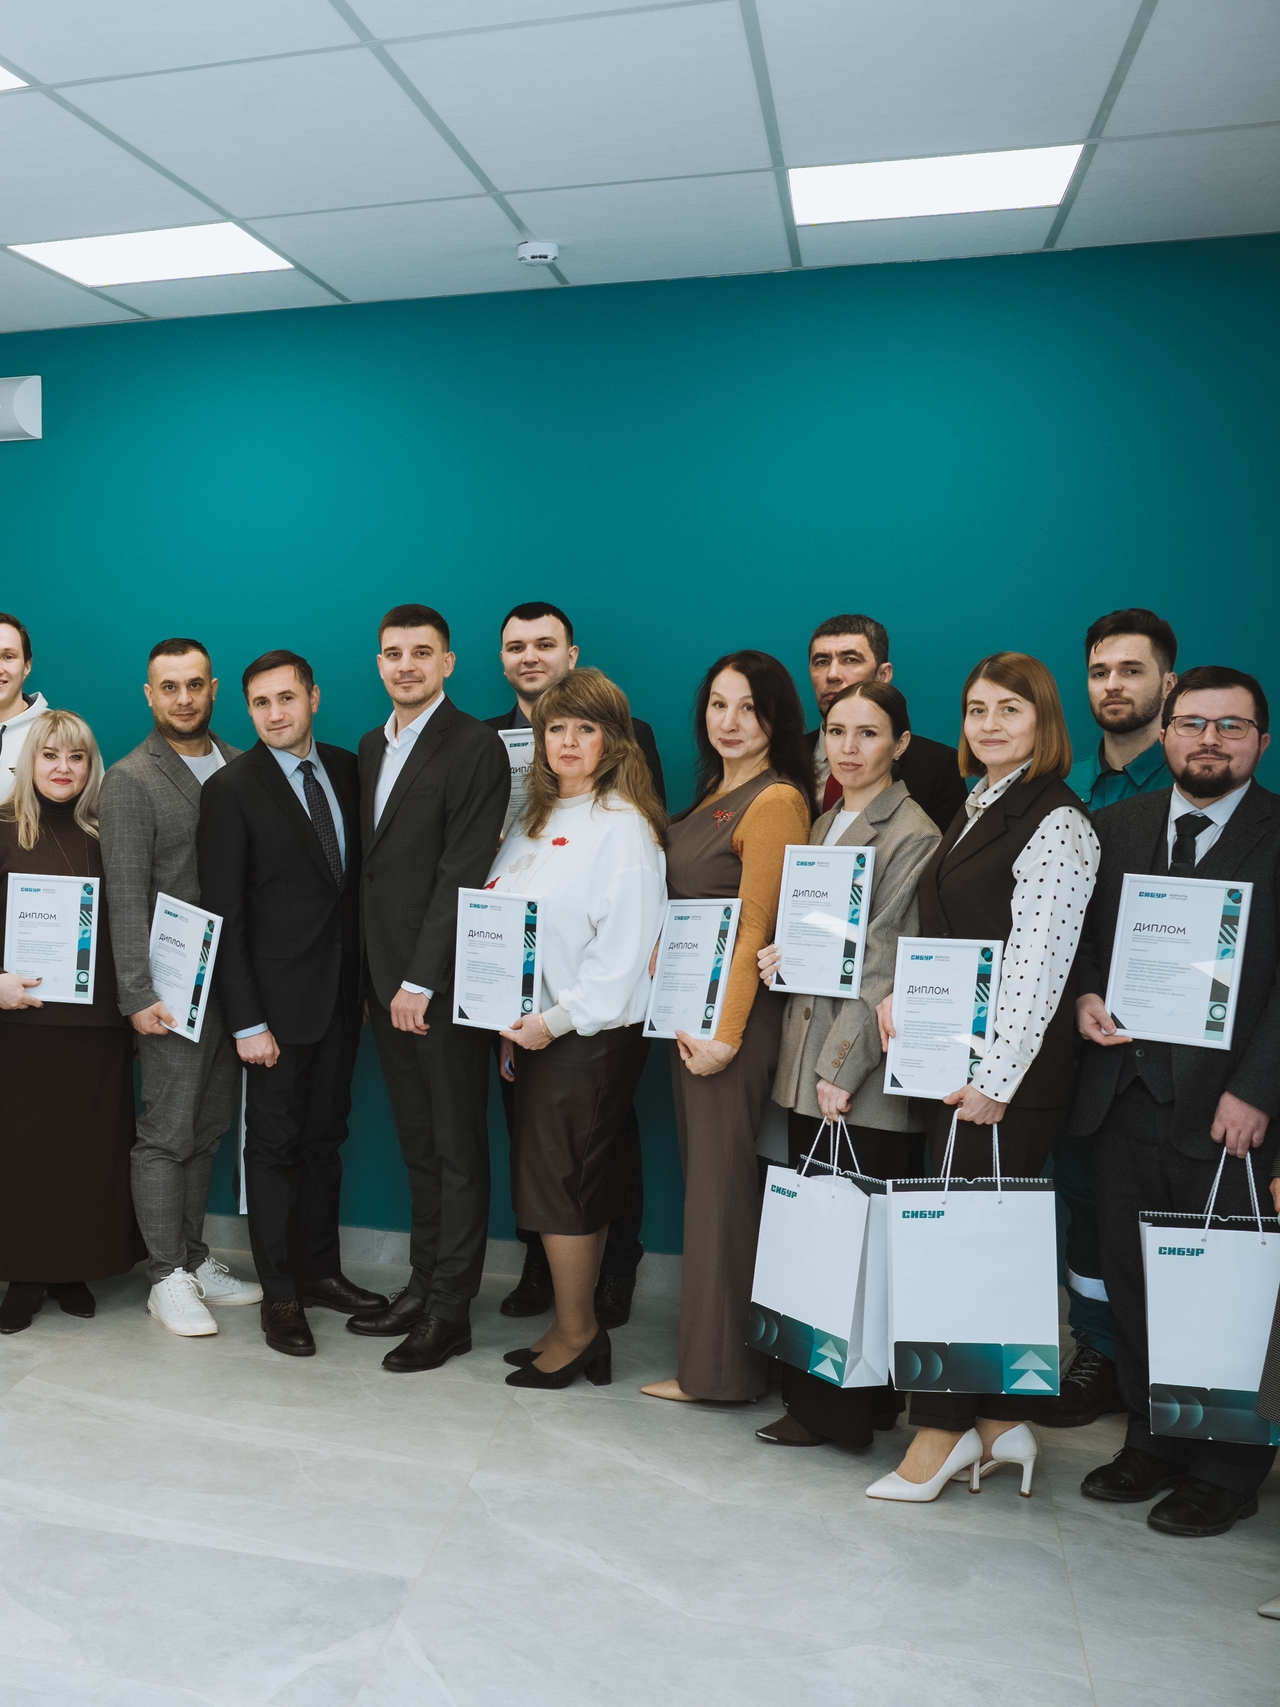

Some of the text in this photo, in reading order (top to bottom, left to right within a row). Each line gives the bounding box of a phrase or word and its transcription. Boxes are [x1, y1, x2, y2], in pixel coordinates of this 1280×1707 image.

[511, 766, 531, 774] ДИПЛ
[792, 889, 828, 898] ДИПЛОМ
[18, 912, 56, 920] ДИПЛОМ
[1133, 923, 1186, 935] ДИПЛОМ
[468, 929, 503, 940] ДИПЛОМ
[159, 933, 186, 950] ДИПЛОМ
[668, 941, 698, 950] ДИПЛОМ
[907, 985, 950, 995] ДИПЛОМ
[770, 1183, 797, 1199] СИБУР
[901, 1210, 945, 1219] СИБУР
[1158, 1246, 1205, 1257] СИБУР
